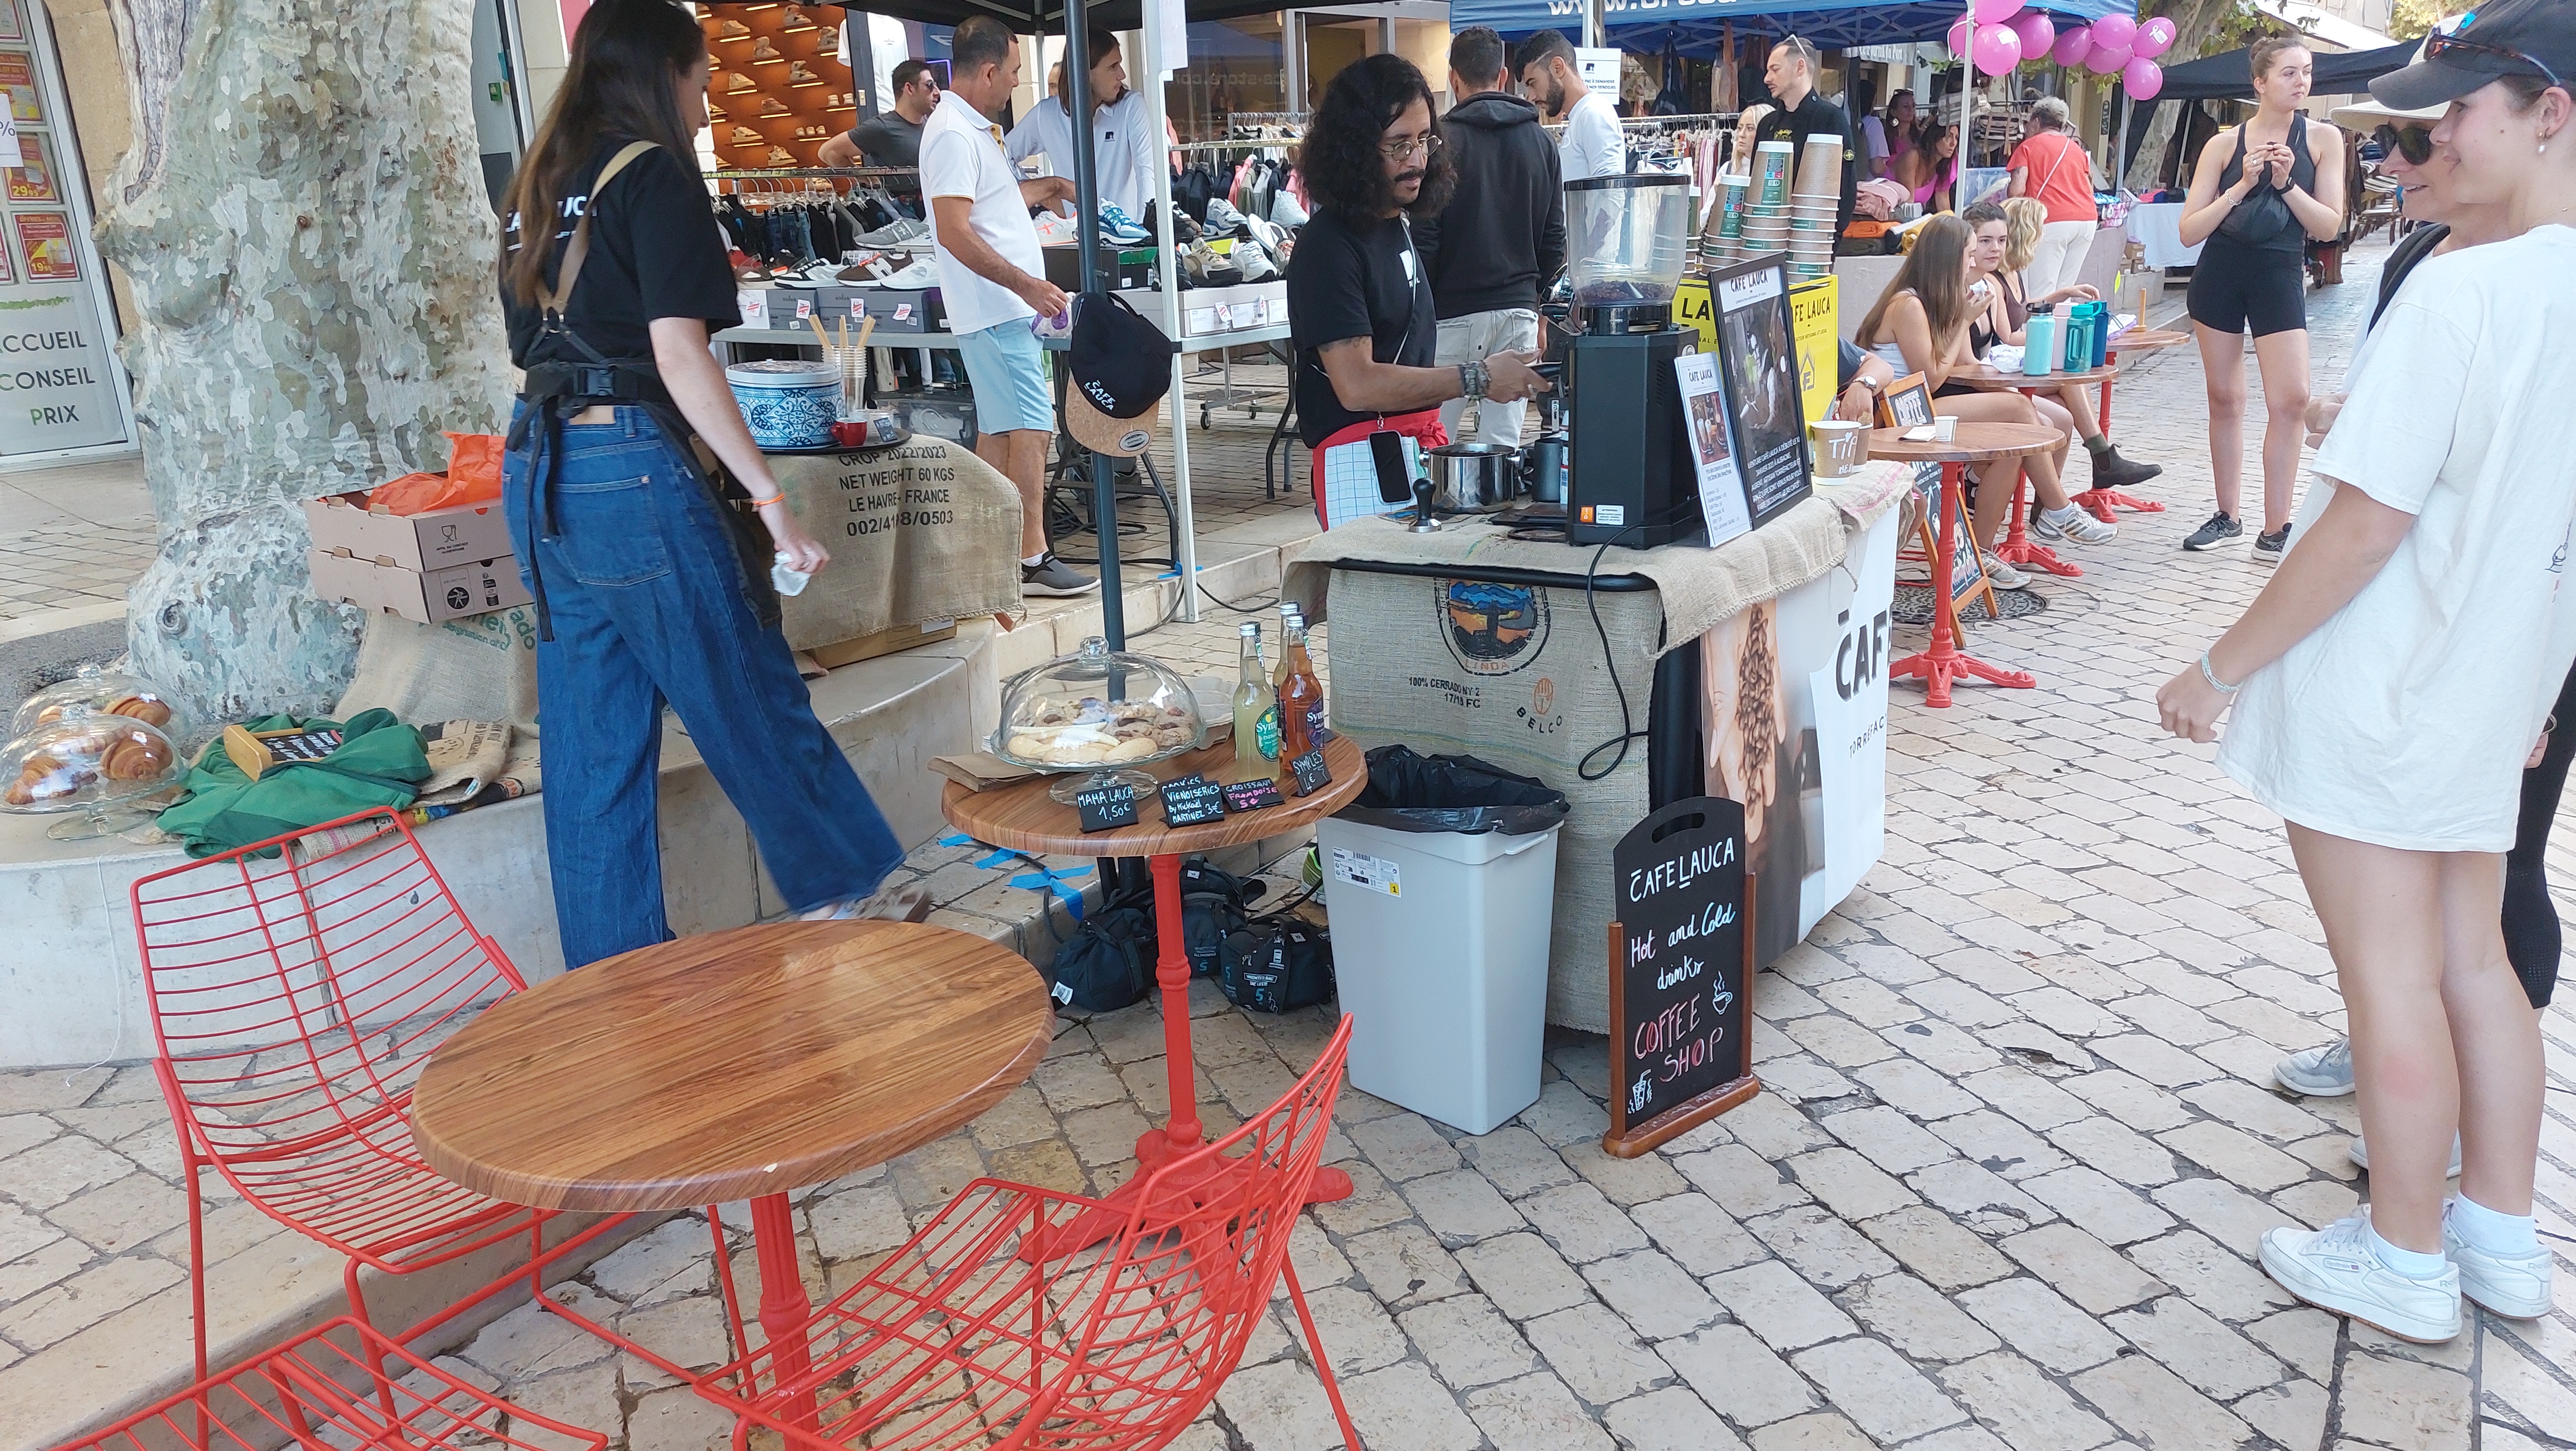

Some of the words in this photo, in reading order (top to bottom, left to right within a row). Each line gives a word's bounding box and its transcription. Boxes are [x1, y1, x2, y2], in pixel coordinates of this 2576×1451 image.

[1807, 296, 1831, 319] LAUCA
[1083, 382, 1114, 411] LAUCA
[1091, 379, 1116, 404] CAFE
[30, 405, 80, 426] PRIX
[838, 452, 880, 466] CROP
[884, 446, 947, 461] 2022/2023
[839, 474, 866, 490] NET
[869, 468, 914, 486] WEIGHT
[919, 468, 931, 481] 60
[933, 468, 954, 481] KGS
[849, 497, 865, 512] LE
[905, 489, 950, 503] FRANCE
[1409, 676, 1428, 688] 100%
[1430, 678, 1462, 695] CERRADO
[1466, 698, 1481, 708] FC
[1516, 705, 1563, 734] BELCO
[1848, 713, 1887, 759] TORRÉFAC
[1292, 749, 1324, 776] SYMPLES
[1225, 780, 1272, 792] CROISSANT
[1228, 786, 1279, 801] FRAMBOISE
[1077, 791, 1108, 809] MAMA
[1108, 786, 1135, 802] LAUCA
[1204, 801, 1224, 815] 3€
[1098, 802, 1131, 822] 1,50€
[1168, 805, 1177, 815] By
[1172, 810, 1206, 824] MARTINEZ
[1630, 929, 1657, 968] Hot
[1668, 914, 1700, 948] and
[1701, 902, 1736, 937] Cold
[1255, 988, 1265, 1002] 5
[1634, 992, 1701, 1060] COFFEE
[1658, 1026, 1724, 1083] SHOP
